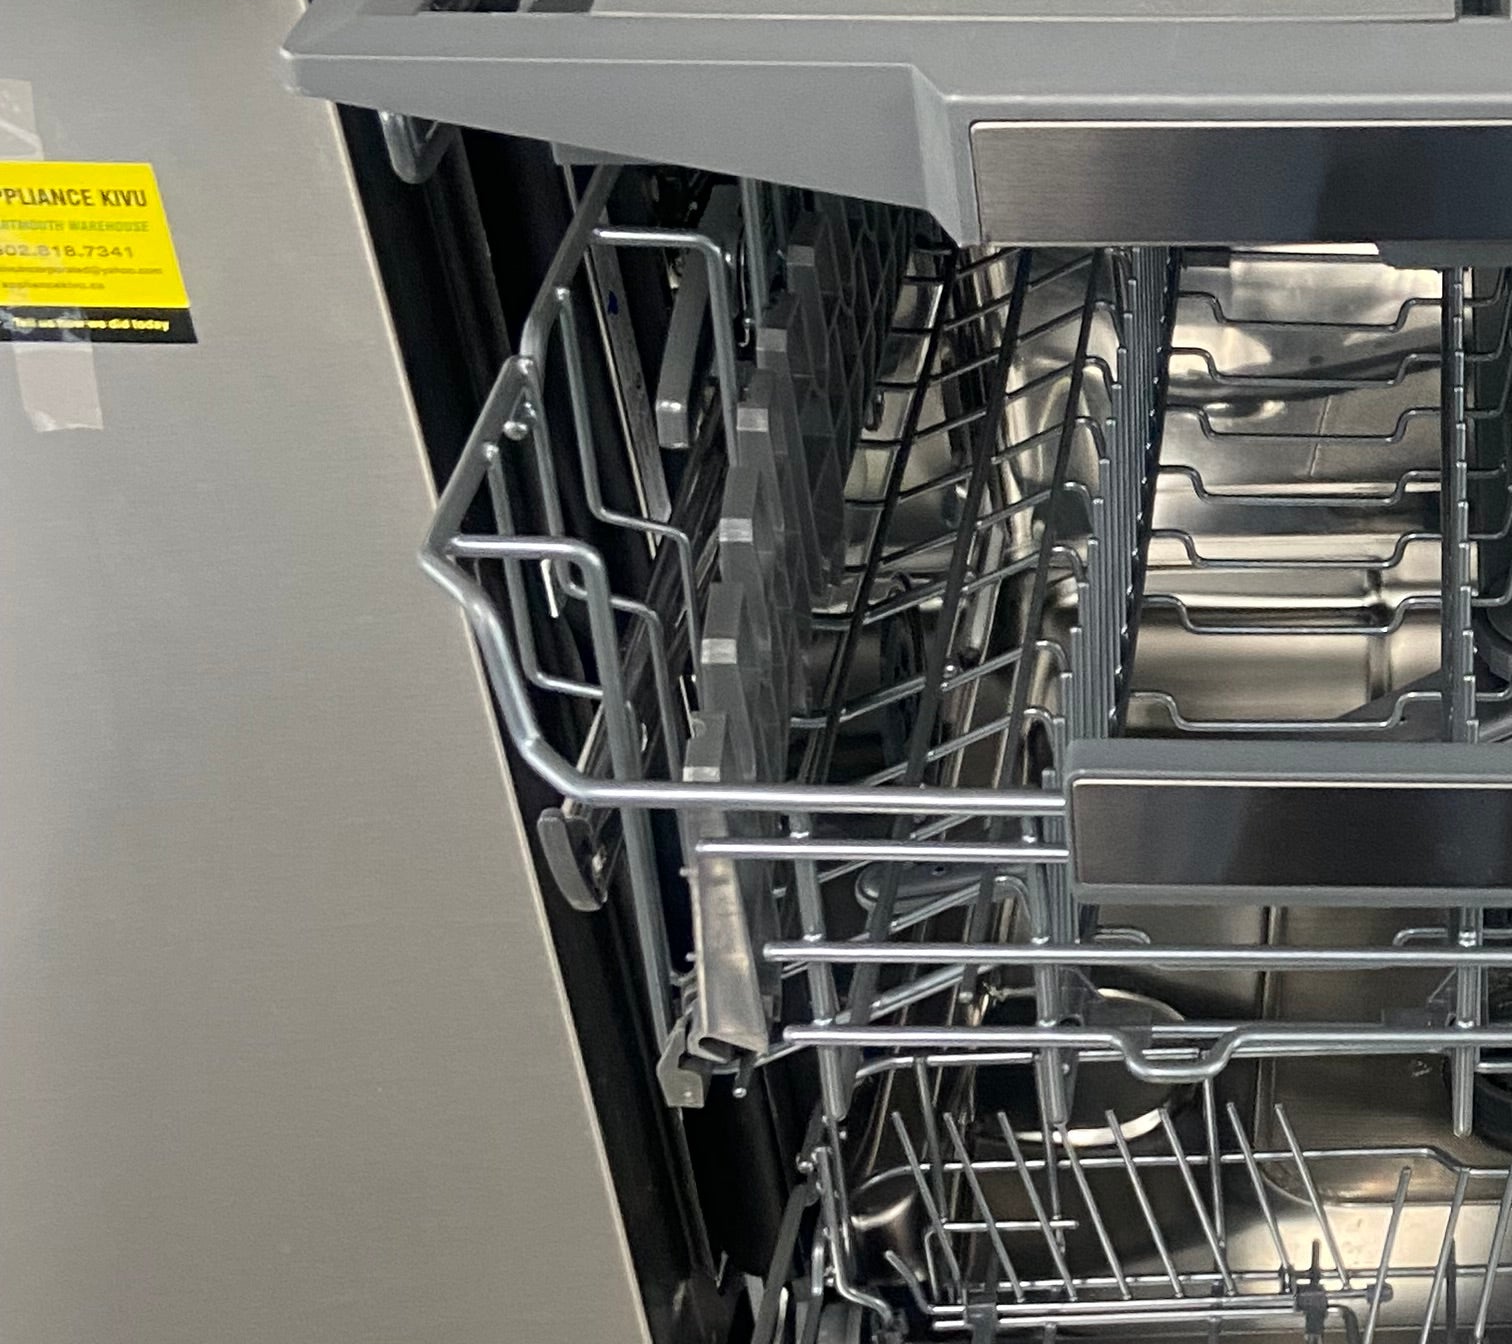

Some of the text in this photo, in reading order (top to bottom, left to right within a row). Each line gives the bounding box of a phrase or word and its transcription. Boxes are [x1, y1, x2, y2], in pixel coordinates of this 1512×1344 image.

[0, 188, 147, 207] PLIANCE KIVU
[132, 319, 169, 332] today
